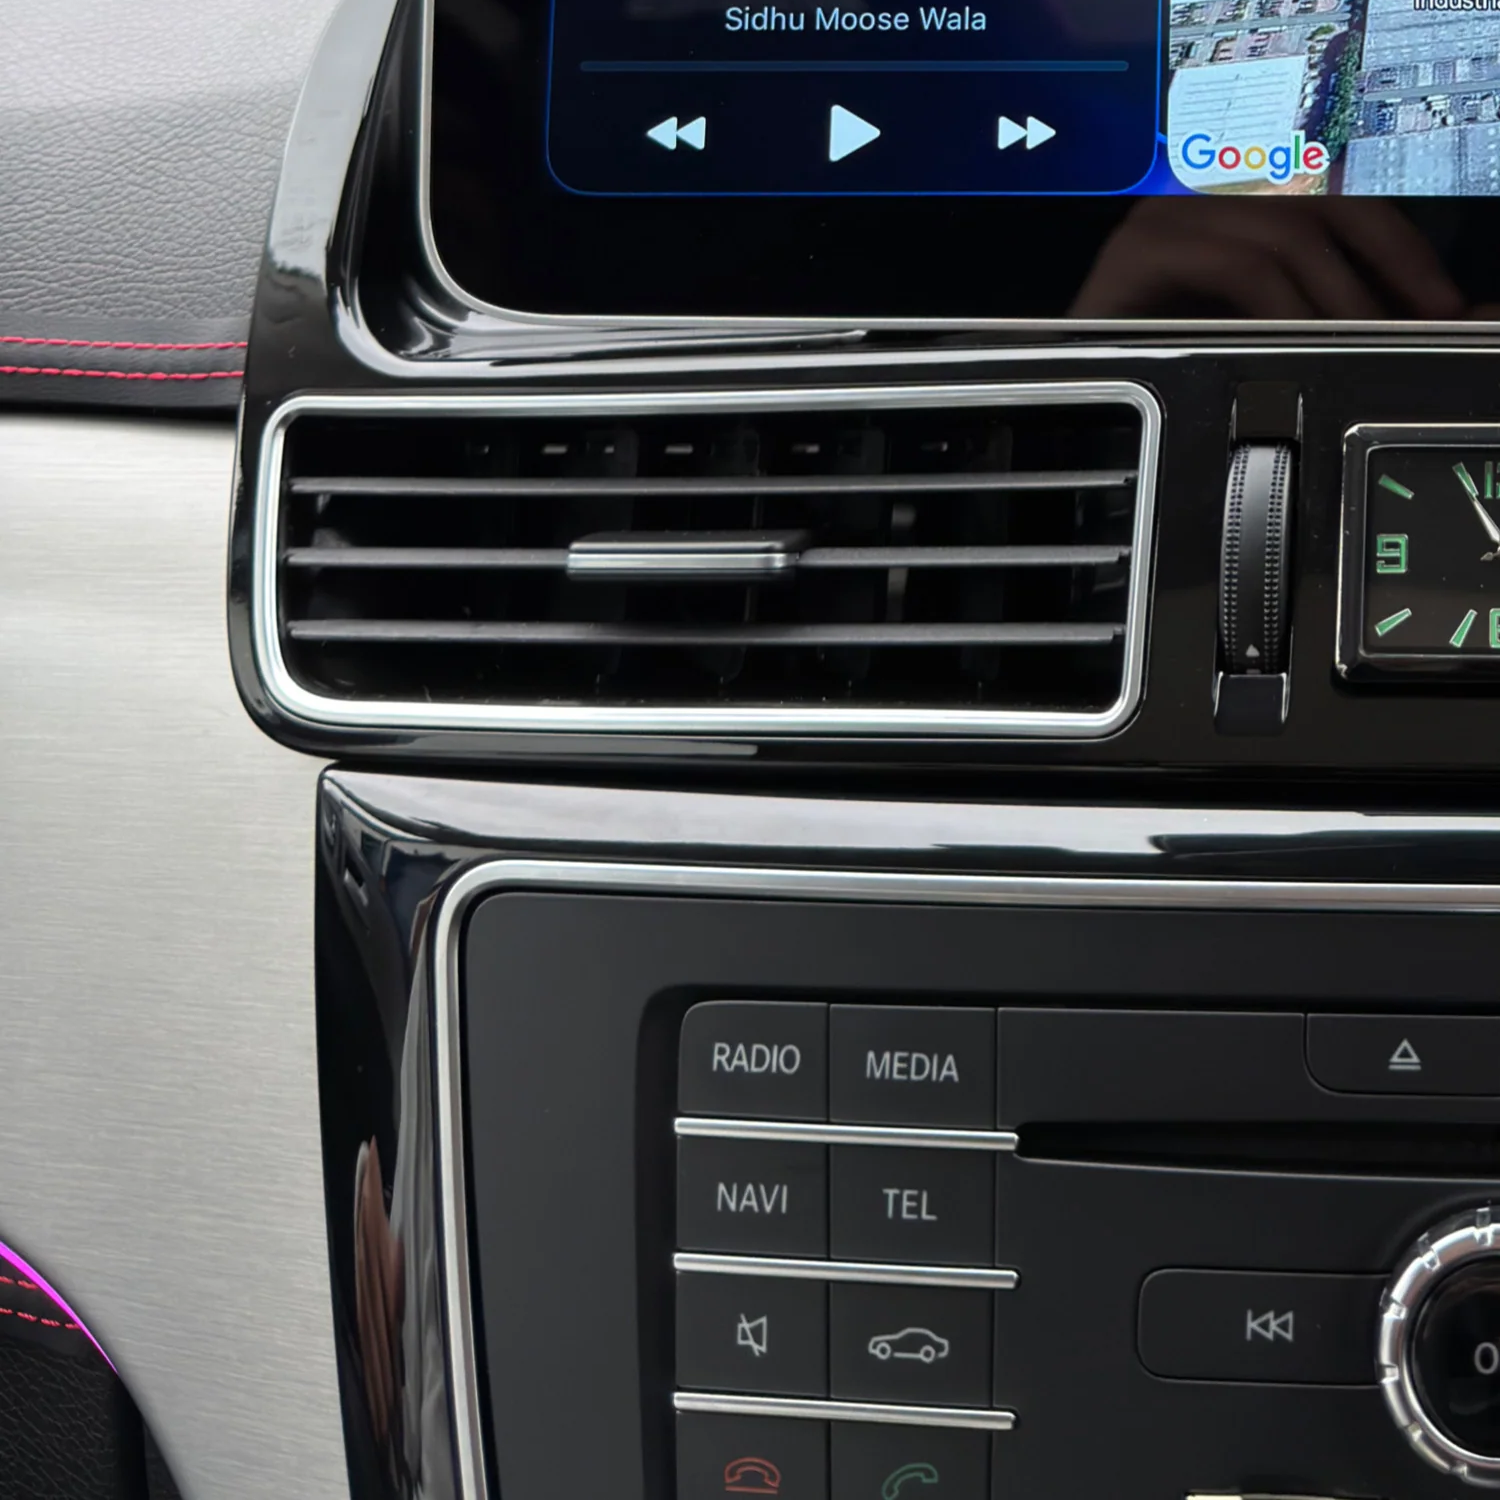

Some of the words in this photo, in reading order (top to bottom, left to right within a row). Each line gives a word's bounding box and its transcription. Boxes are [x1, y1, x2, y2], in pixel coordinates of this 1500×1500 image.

[724, 6, 805, 32] Sidhu
[815, 7, 910, 32] Moose
[919, 6, 987, 32] Wala
[1181, 133, 1327, 180] Google
[1376, 533, 1409, 574] 9
[712, 1042, 801, 1075] RADIO
[865, 1051, 960, 1083] MEDIA
[716, 1182, 789, 1215] NAVI
[882, 1188, 938, 1221] TEL
